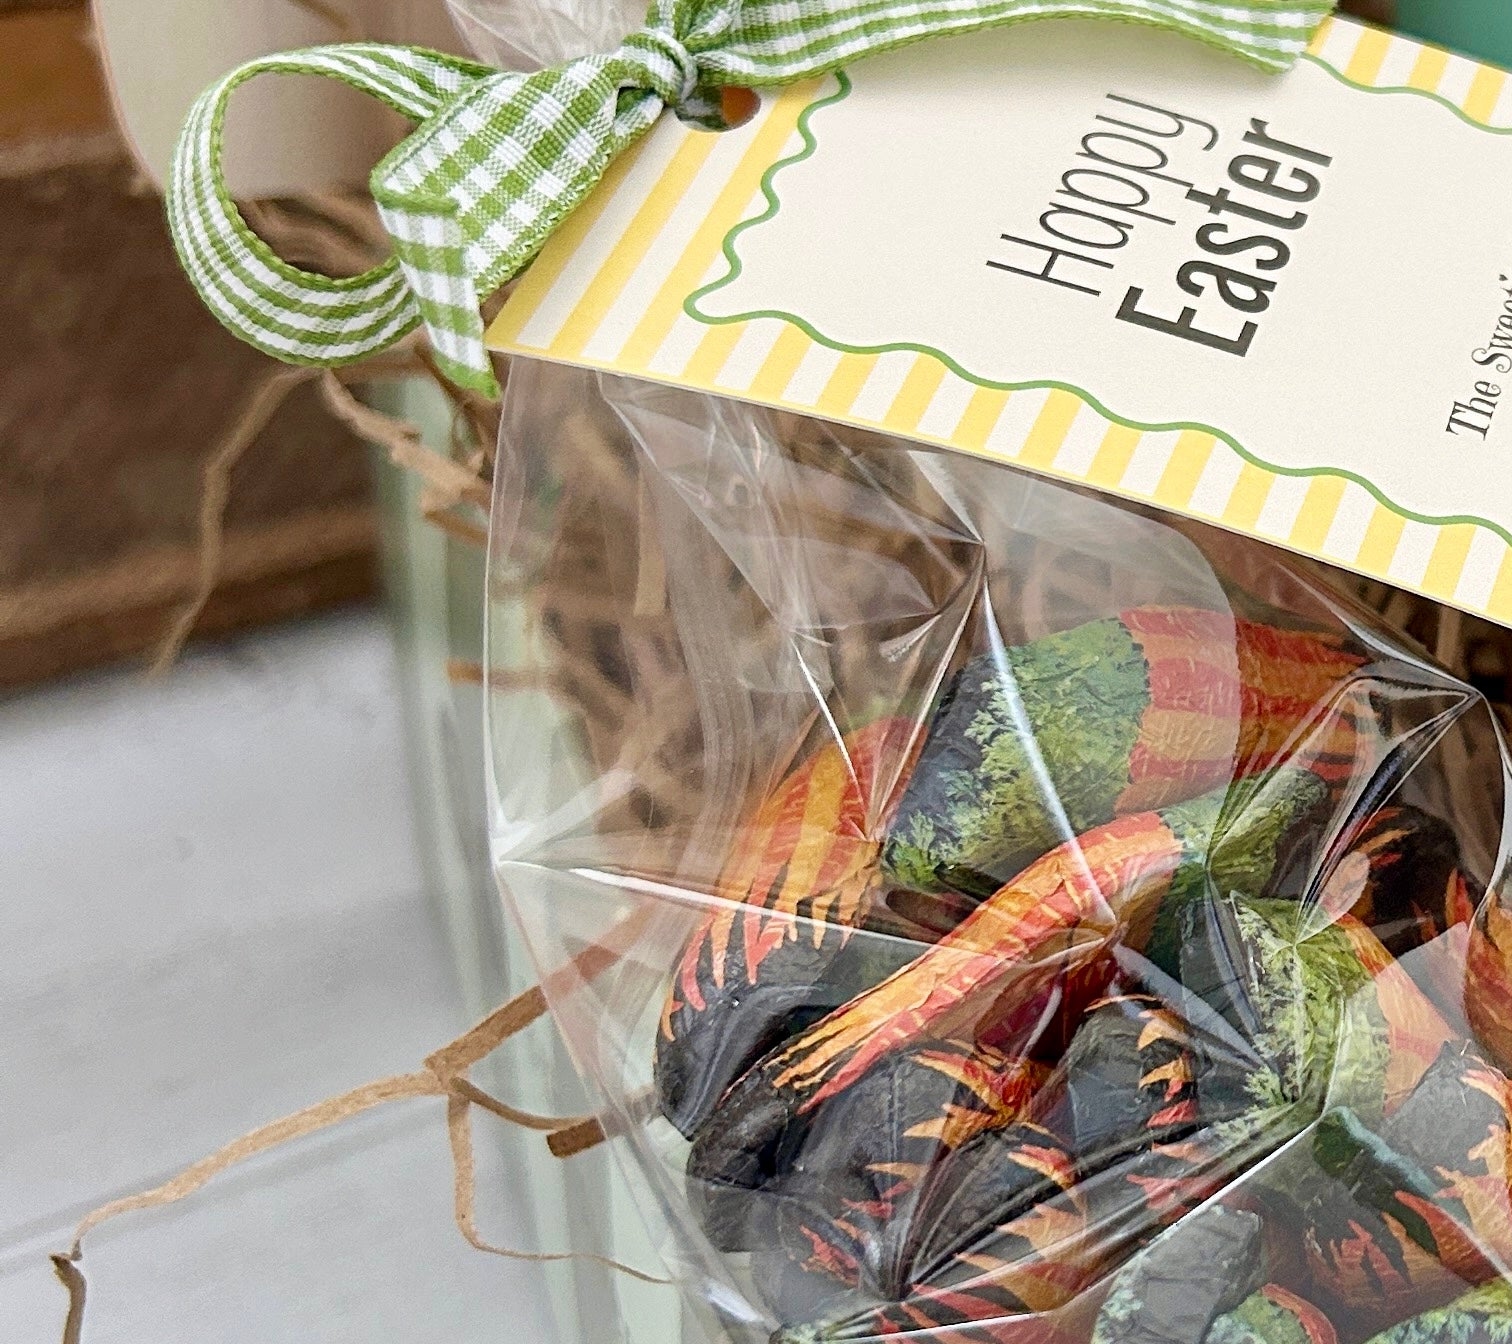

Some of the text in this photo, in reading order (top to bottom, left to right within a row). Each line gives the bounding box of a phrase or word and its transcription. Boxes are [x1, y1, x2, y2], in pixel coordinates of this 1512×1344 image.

[986, 93, 1219, 296] Happy
[1115, 117, 1332, 357] Easter
[1446, 380, 1501, 441] The
